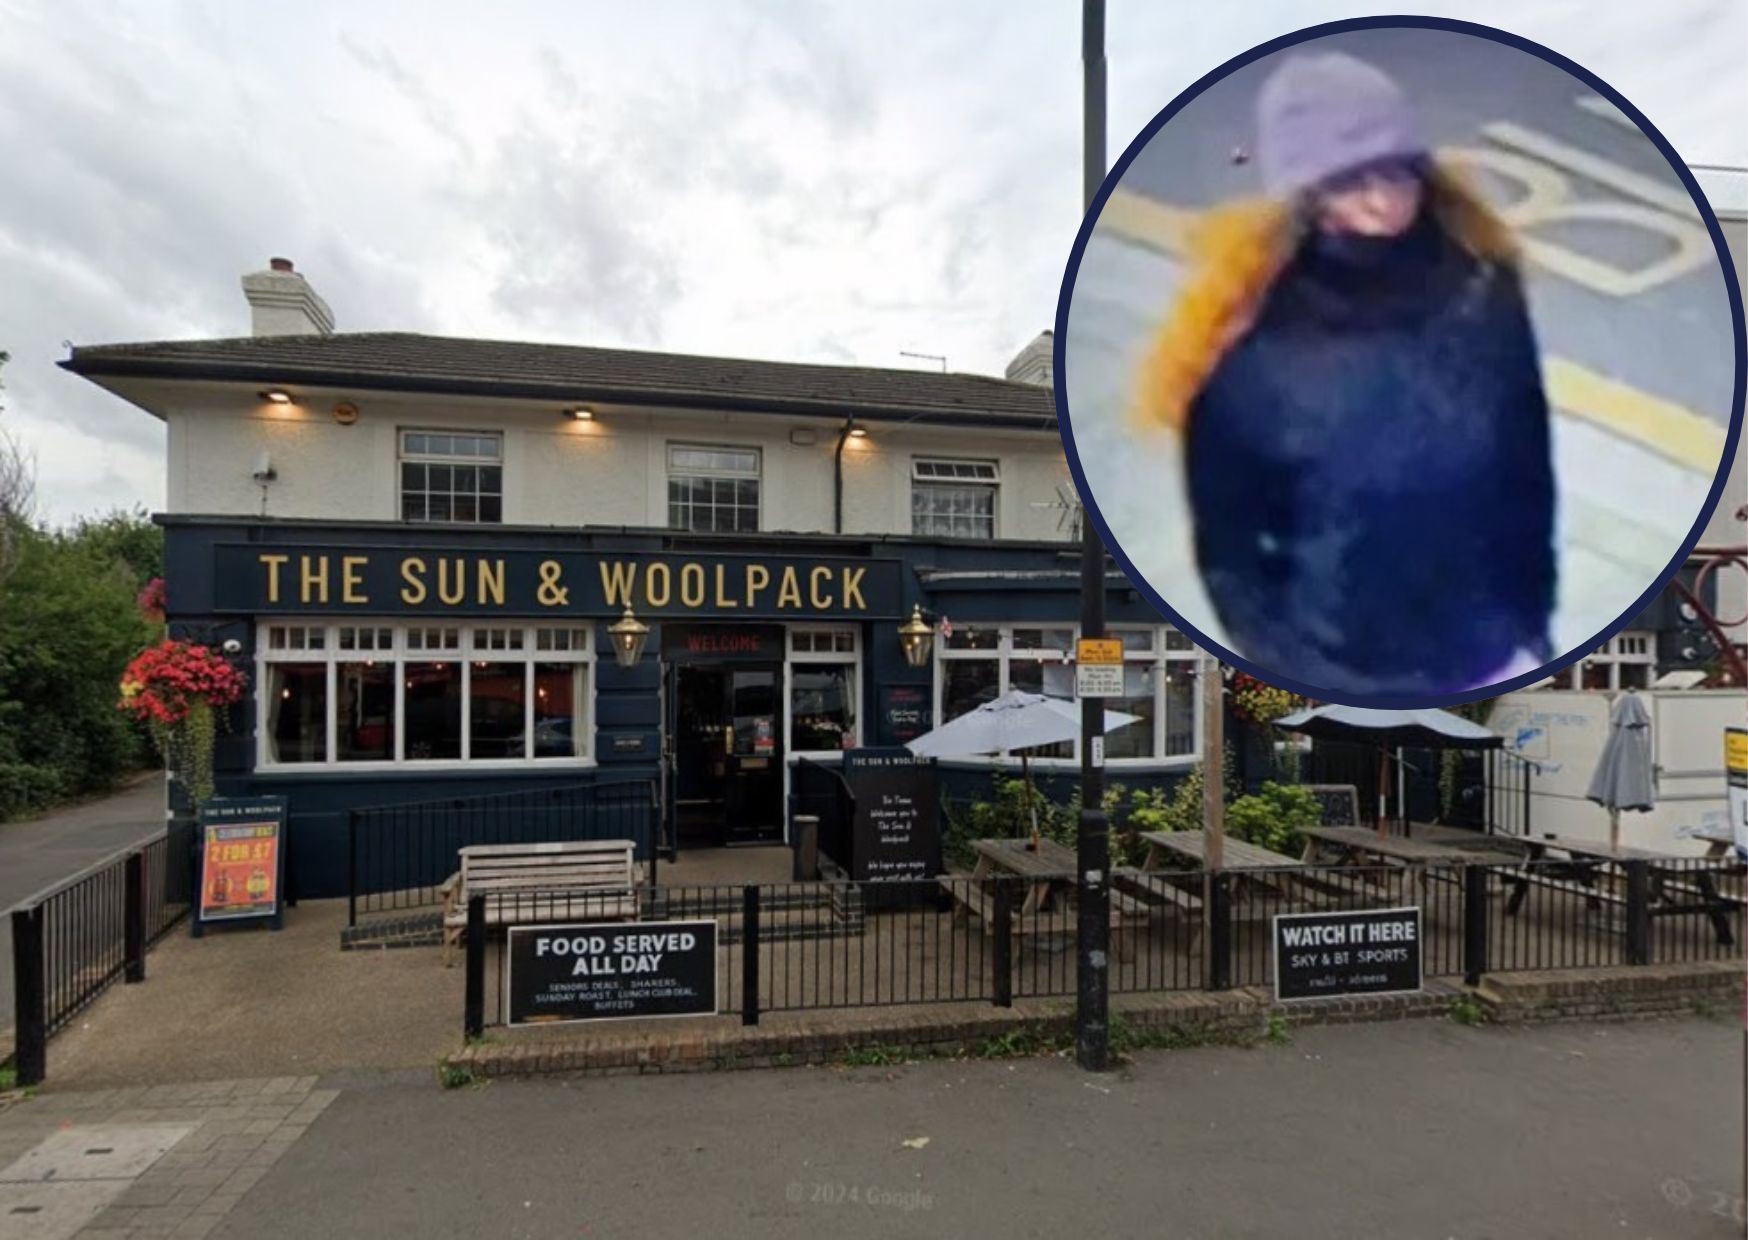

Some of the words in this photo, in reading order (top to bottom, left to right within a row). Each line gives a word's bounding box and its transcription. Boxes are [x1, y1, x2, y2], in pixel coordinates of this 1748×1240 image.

[259, 554, 369, 603] THE
[400, 557, 505, 604] SUN
[537, 560, 569, 606] &
[599, 560, 867, 610] WOOLPACK
[687, 634, 760, 651] WELCOME
[852, 757, 866, 766] THE
[1282, 924, 1346, 947] WATCH
[1350, 923, 1365, 943] IT
[1369, 920, 1416, 942] HERE
[536, 937, 606, 957] FOOD
[613, 933, 695, 953] SERVED
[572, 956, 615, 976] ALL
[621, 954, 664, 974] DAY
[1291, 953, 1318, 968] SKY
[1321, 952, 1331, 966] &
[1334, 951, 1349, 965] BT
[1357, 948, 1409, 964] SPORTS
[549, 982, 589, 992] SENIORS
[535, 993, 575, 1003] SUNDAY
[594, 1000, 635, 1010] BUFFETS
